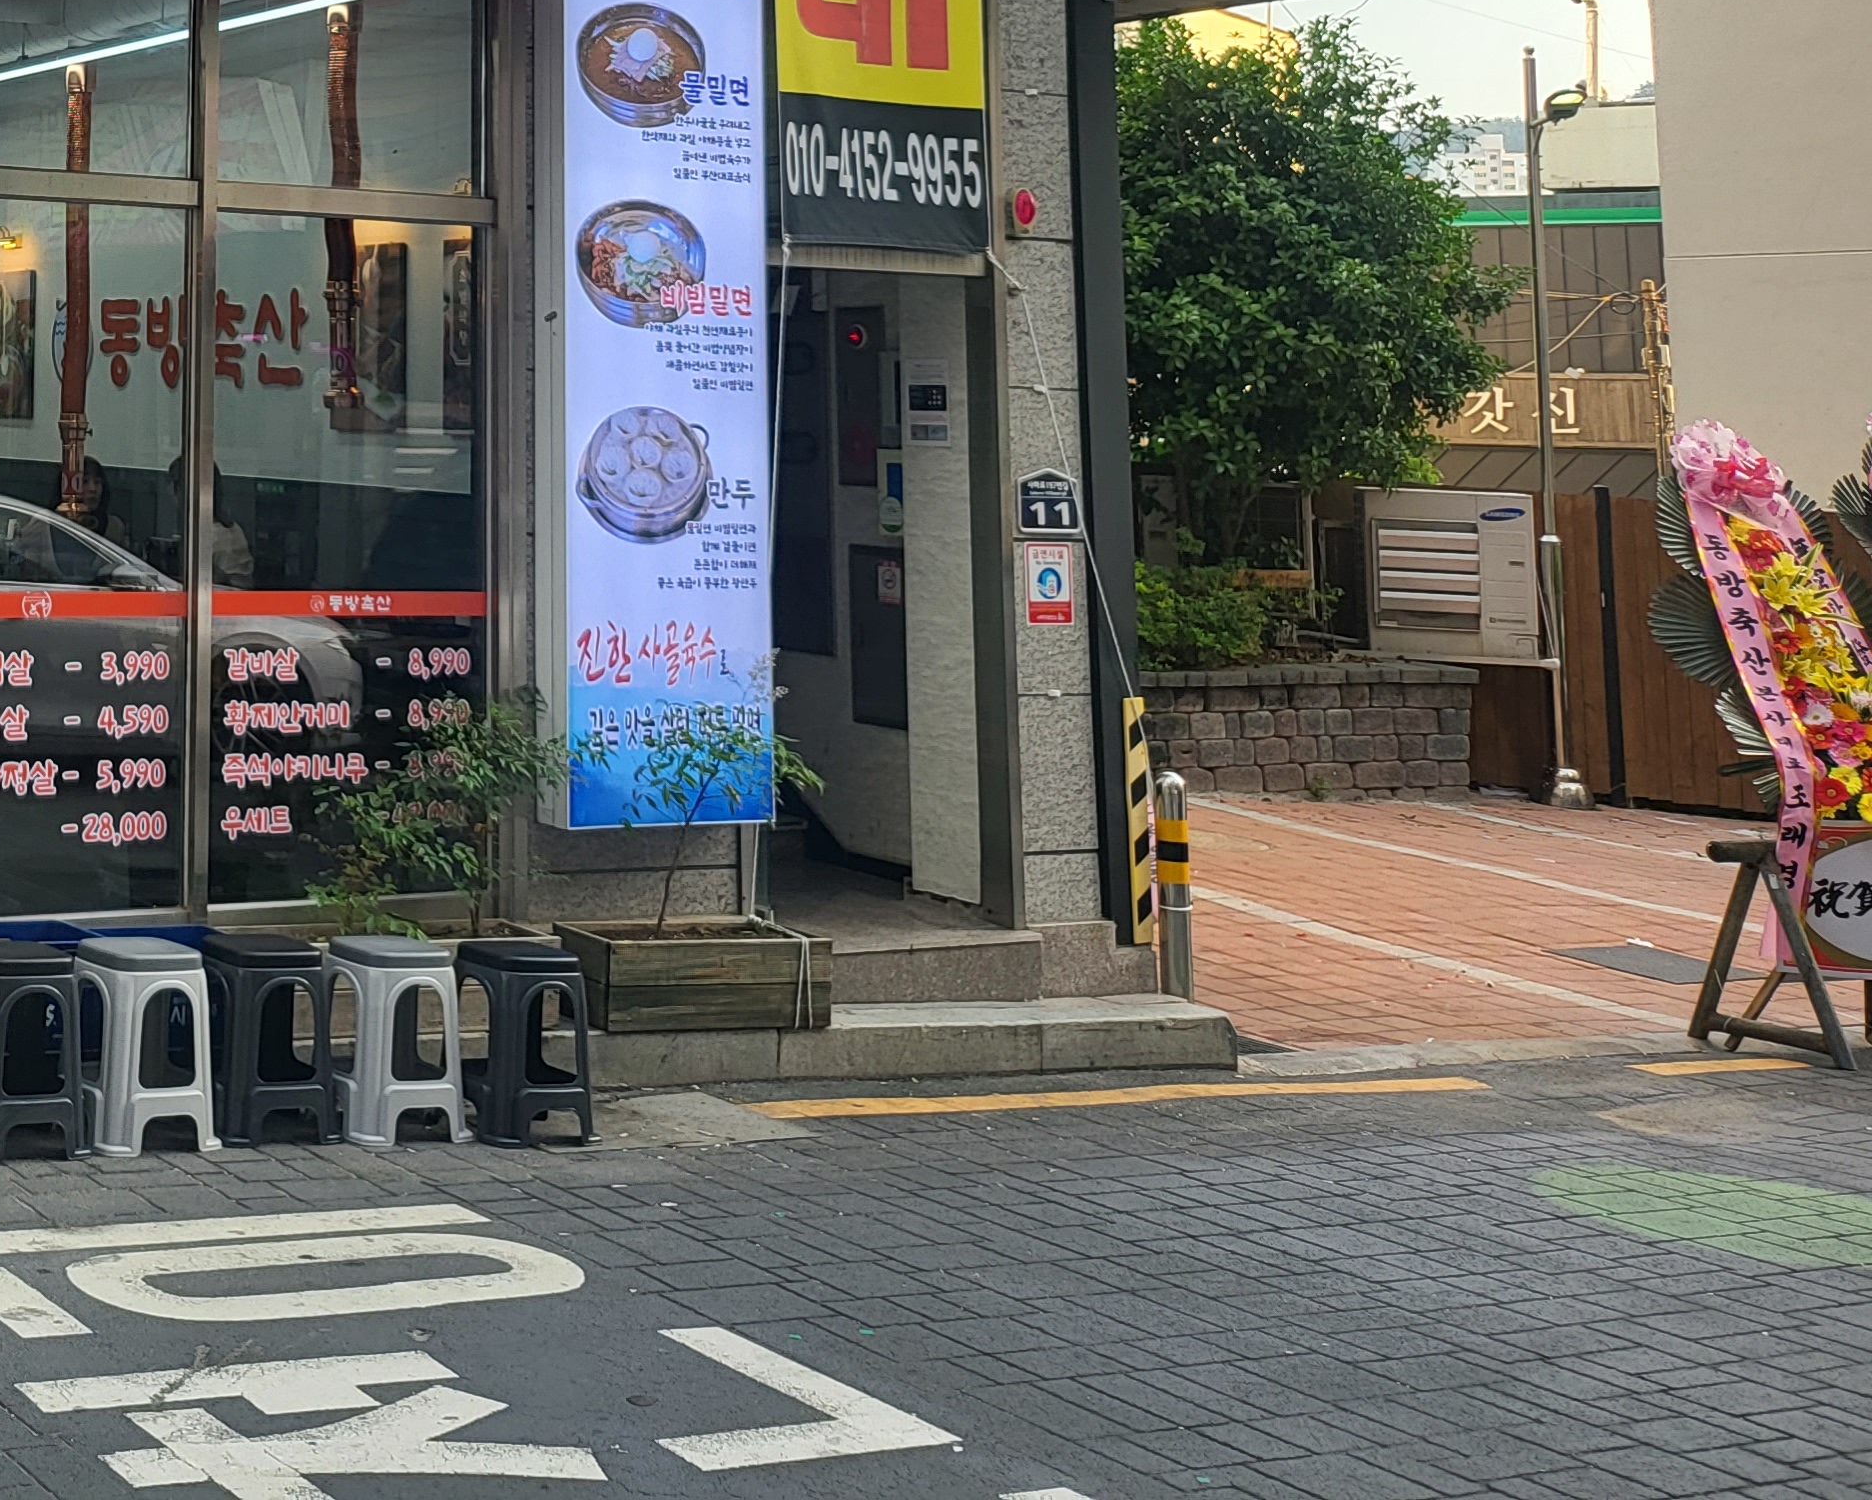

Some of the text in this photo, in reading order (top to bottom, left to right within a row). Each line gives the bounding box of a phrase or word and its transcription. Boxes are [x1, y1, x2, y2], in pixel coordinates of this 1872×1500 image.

[679, 71, 749, 107] 물밀면
[786, 119, 982, 211] 010-4152-9955
[660, 280, 752, 317] 비빔밀면
[707, 477, 755, 510] 만두
[1029, 501, 1070, 526] 11
[328, 594, 391, 613] 동방축산
[1704, 534, 1771, 676] 동방축산
[99, 649, 171, 682] 3,990
[225, 647, 471, 681] 갈비살 8,990
[577, 620, 631, 684] 진한
[97, 704, 170, 740] 4,590
[224, 700, 350, 735] 황제안거미
[95, 757, 166, 793] 5,990
[222, 752, 369, 788] 즉석야키니쿠
[221, 806, 292, 840] 우세트
